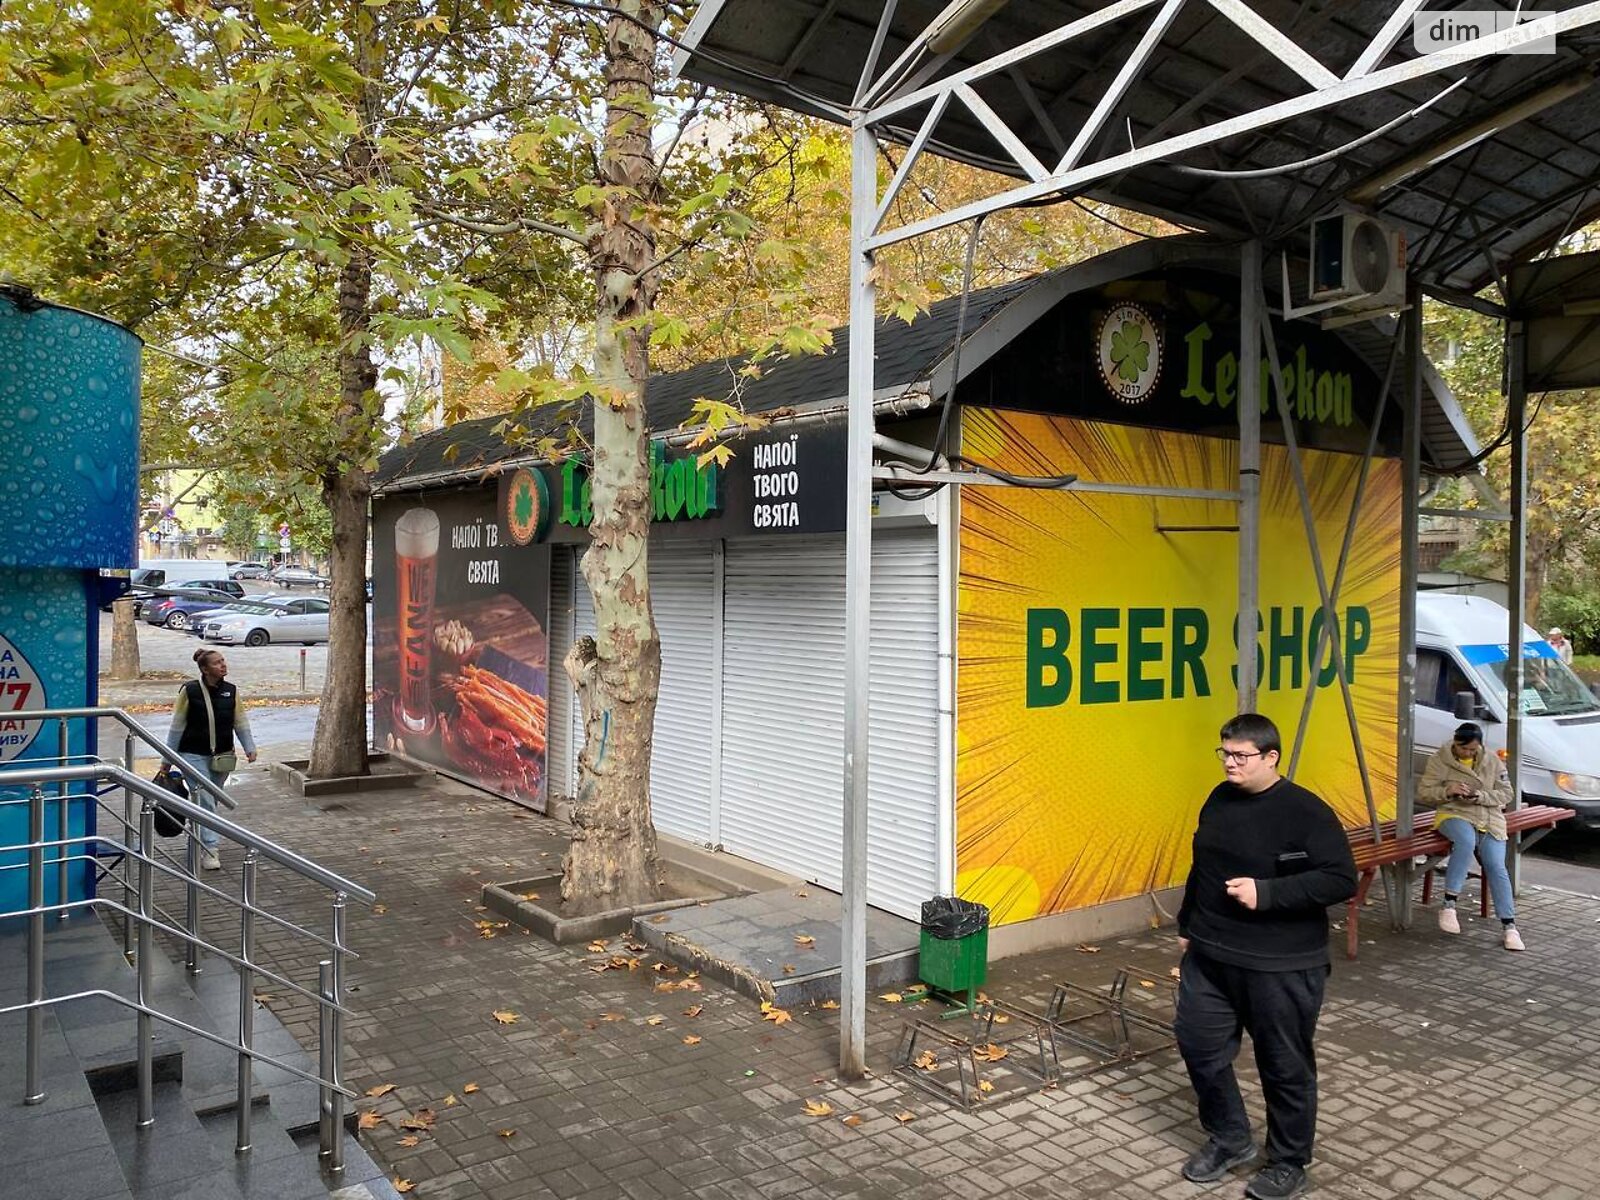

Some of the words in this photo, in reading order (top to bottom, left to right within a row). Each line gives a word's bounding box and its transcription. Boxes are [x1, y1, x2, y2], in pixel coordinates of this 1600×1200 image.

[1120, 383, 1141, 395] 2017
[1180, 322, 1352, 427] Lerekon
[753, 434, 798, 469] НАПОЇ
[753, 471, 799, 498] ТВОГО
[753, 502, 800, 527] СВЯТА
[452, 518, 481, 549] НАПОЇ
[468, 559, 500, 584] СВЯТА
[1026, 608, 1211, 709] BEER
